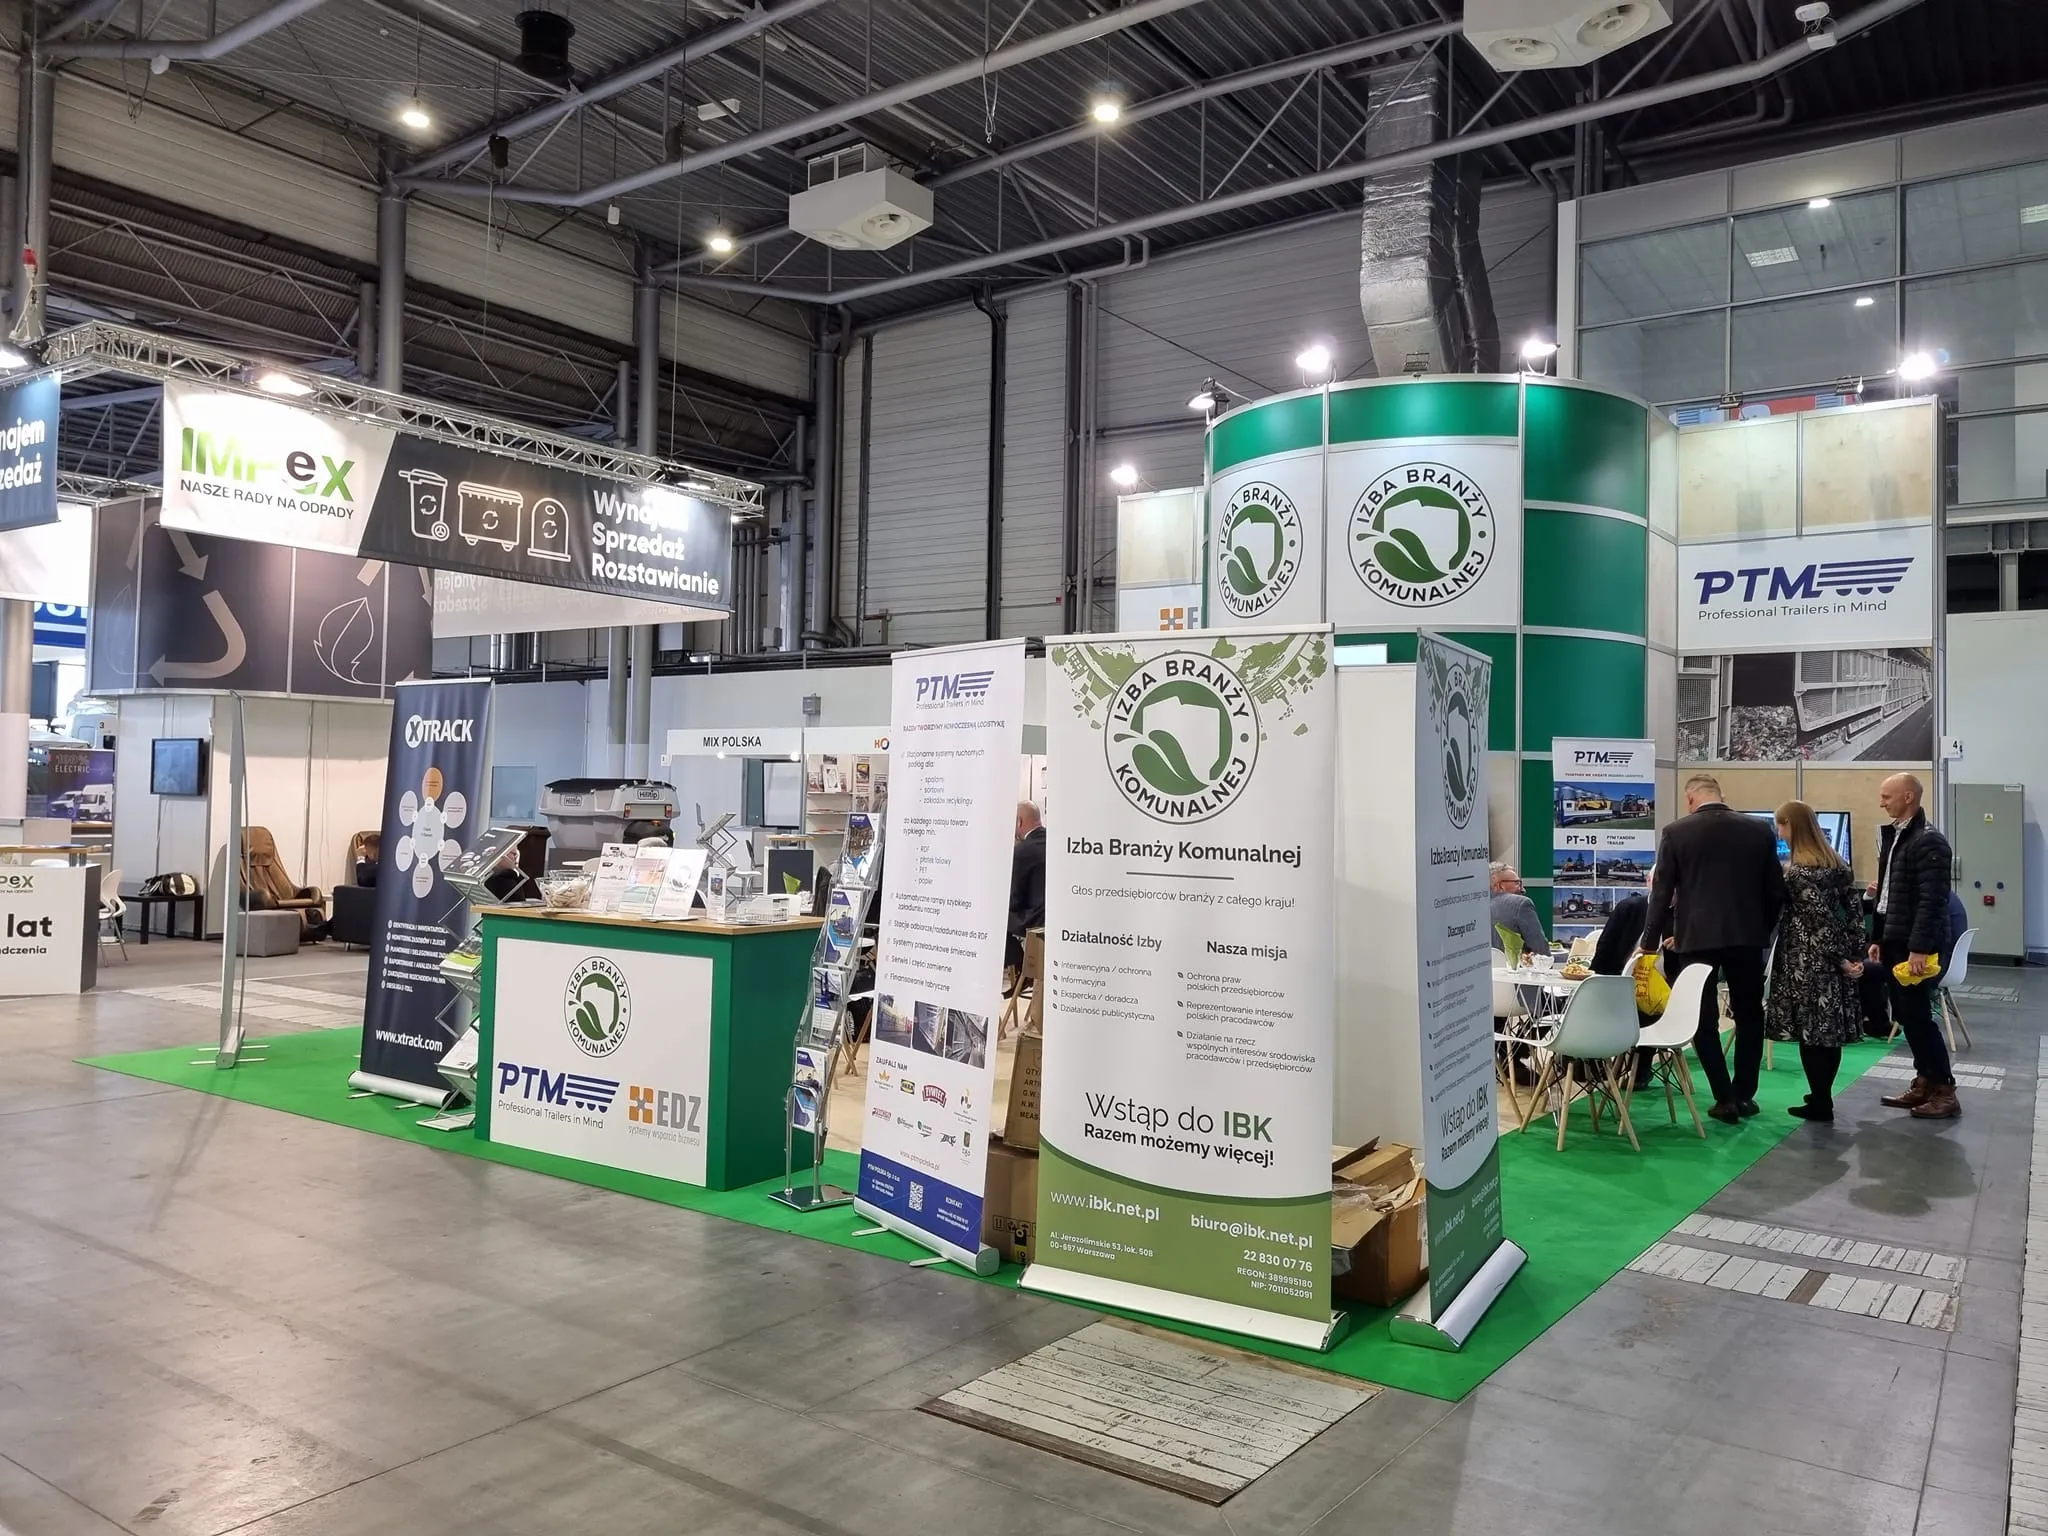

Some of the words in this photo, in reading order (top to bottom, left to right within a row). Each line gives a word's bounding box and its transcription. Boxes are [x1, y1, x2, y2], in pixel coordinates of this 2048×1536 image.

[180, 479, 231, 499] NASZE
[234, 488, 274, 507] RADY
[277, 497, 297, 510] NA
[299, 499, 354, 521] ODPADY
[1357, 479, 1398, 523] IZBA
[1406, 468, 1487, 521] BRANŻY
[1220, 503, 1239, 545] IZBA
[1242, 487, 1296, 528] BRANŻY
[592, 521, 685, 561] Sprzedaż
[592, 552, 719, 596] Rozstawianie
[1221, 560, 1294, 613] KOMUNALNEJ
[1359, 550, 1486, 603] KOMUNALNEJ
[1694, 564, 1823, 605] PTM
[1699, 604, 1777, 620] Professional
[1780, 602, 1829, 617] Trailers
[1833, 602, 1846, 613] in
[1850, 599, 1887, 613] Mind
[916, 674, 961, 702] PTM
[1114, 671, 1157, 722] IZBA
[1165, 659, 1249, 719] BRANŻY
[405, 715, 473, 748] XTRACK
[703, 736, 719, 748] MIX
[722, 736, 762, 749] POLSKA
[55, 765, 91, 774] ELECTRIC
[1574, 751, 1610, 763] PTM
[1115, 757, 1247, 818] KOMUNALNEJ
[1566, 835, 1597, 845] PT-18
[1067, 837, 1104, 856] Izba
[1109, 838, 1174, 863] Branży
[1178, 841, 1302, 869] Komunalnej
[1071, 885, 1093, 897] Głos
[1095, 887, 1177, 903] przedsiębiorców
[1179, 891, 1215, 905] branży
[1217, 895, 1224, 904] z
[1226, 894, 1262, 909] całego
[1264, 896, 1295, 910] kraju!
[7, 913, 52, 938] lat
[1061, 929, 1134, 947] Działalność
[1136, 935, 1162, 952] Izby
[1206, 941, 1247, 956] Nasza
[1251, 945, 1288, 961] misja
[569, 966, 588, 995] IZBA
[591, 961, 628, 999] BRANŻY
[1061, 976, 1106, 987] Informacyjna
[1118, 966, 1152, 976] ochronna
[1187, 972, 1220, 983] Ochrona
[1222, 975, 1242, 984] praw
[1060, 990, 1097, 1001] Ekspercka
[1105, 994, 1139, 1005] doradcza
[1187, 982, 1219, 992] polskich
[1060, 1004, 1100, 1015] Działalność
[1102, 1008, 1155, 1021] publicystyczna
[1187, 1001, 1253, 1015] Reprezentowanie
[1255, 1007, 1293, 1019] interesów
[1187, 1012, 1219, 1022] polskich
[376, 1029, 443, 1053] www.xtrack.com
[569, 1019, 626, 1055] KOMUNALNEJ
[1187, 1031, 1222, 1042] Działanie
[1235, 1037, 1256, 1046] rzecz
[1186, 1052, 1241, 1065] pracodawców
[1246, 1059, 1312, 1073] przedsiębiorców
[1187, 1042, 1229, 1054] wspólnych
[1230, 1047, 1267, 1058] interesów
[497, 1062, 569, 1106] PTM
[657, 1090, 702, 1133] EDZ
[1466, 1094, 1476, 1119] do
[1476, 1082, 1489, 1111] IBK
[498, 1100, 542, 1117] Professional
[544, 1109, 571, 1122] Trailers
[573, 1114, 581, 1125] in
[582, 1117, 604, 1129] Mind
[1085, 1091, 1169, 1133] Wstąp
[1178, 1106, 1214, 1133] do
[1224, 1110, 1273, 1143] IBK
[1084, 1123, 1136, 1145] Razem
[1141, 1133, 1210, 1159] możemy
[1214, 1146, 1274, 1168] więcej!
[1050, 1190, 1160, 1223] www.ibk.net.pl
[1060, 1233, 1111, 1250] Jerozolimskie
[1112, 1241, 1123, 1252] 53,
[1124, 1244, 1138, 1254] lok.
[1191, 1214, 1313, 1250] biuro@ibk.net.pl
[1076, 1245, 1115, 1260] Warszawa
[1243, 1249, 1257, 1261] 22
[1259, 1252, 1280, 1266] 830
[1282, 1257, 1298, 1269] 07
[1299, 1260, 1313, 1273] 76
[1237, 1266, 1268, 1281] REGON:
[1268, 1273, 1313, 1289] 389995180
[1251, 1280, 1267, 1291] NIP:
[1268, 1283, 1313, 1300] 7011052091
